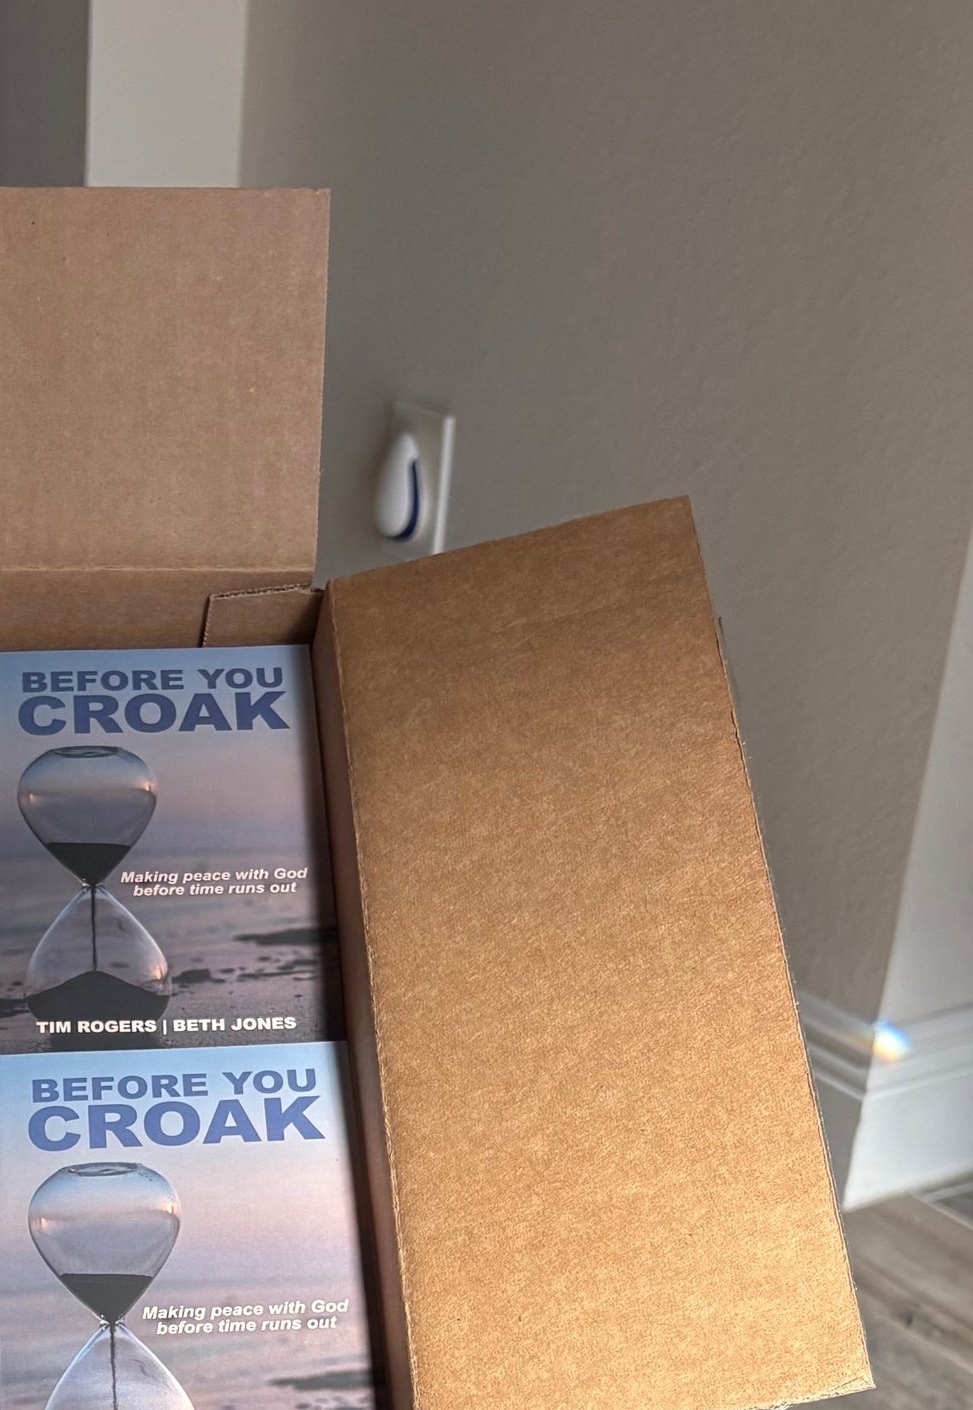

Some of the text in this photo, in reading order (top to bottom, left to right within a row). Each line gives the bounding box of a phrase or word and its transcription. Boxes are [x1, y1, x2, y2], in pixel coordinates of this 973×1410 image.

[22, 667, 283, 693] BEFORE YOU
[18, 691, 290, 736] CROAK
[121, 868, 307, 885] Making peace with God
[133, 882, 297, 896] before time runs out
[36, 1020, 71, 1034] TIM
[78, 1020, 157, 1034] ROGERS
[173, 1018, 225, 1031] BETH
[231, 1016, 297, 1031] JONES
[32, 1068, 317, 1103] BEFORE YOU
[28, 1095, 325, 1151] CROAK
[142, 1299, 349, 1321] Making peace with God
[156, 1316, 337, 1334] before time runs out
